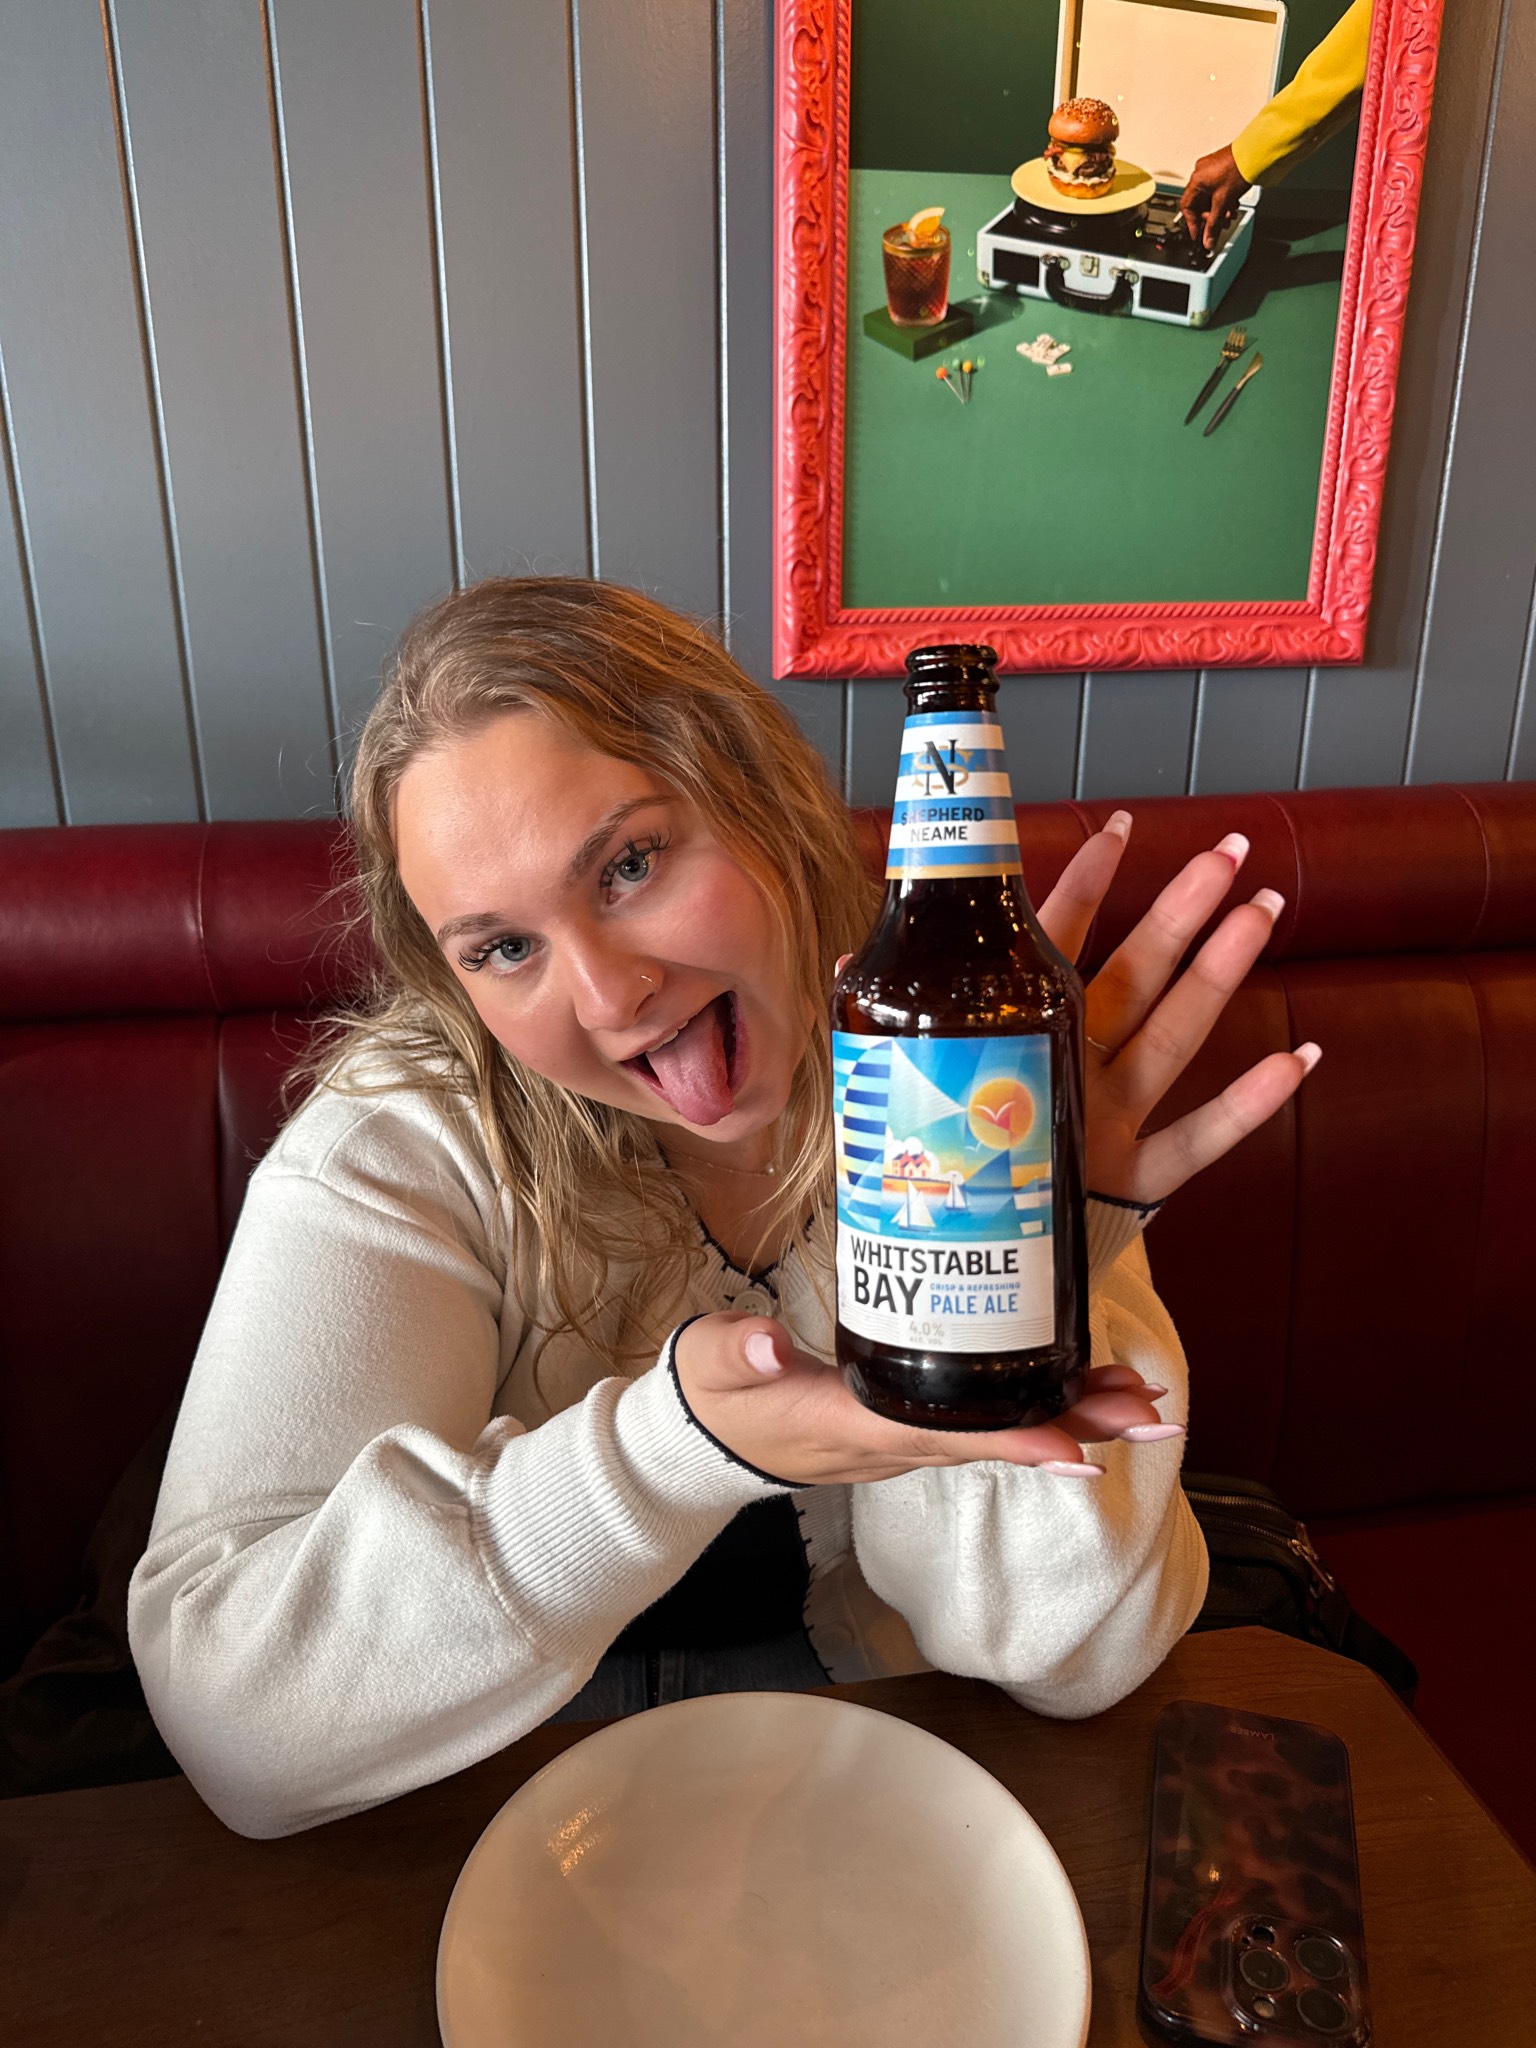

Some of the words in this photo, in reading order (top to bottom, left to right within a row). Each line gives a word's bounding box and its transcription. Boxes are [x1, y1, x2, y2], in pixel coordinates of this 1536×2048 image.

[901, 807, 985, 826] SHEPHERD
[910, 825, 968, 842] NEAME
[851, 1235, 1019, 1275] WHITSTABLE
[854, 1265, 923, 1315] BAY
[929, 1283, 956, 1291] CRISP
[967, 1281, 1021, 1292] REFRESHING
[931, 1294, 976, 1314] PALE
[984, 1293, 1018, 1313] ALE
[909, 1321, 944, 1336] 4.0%
